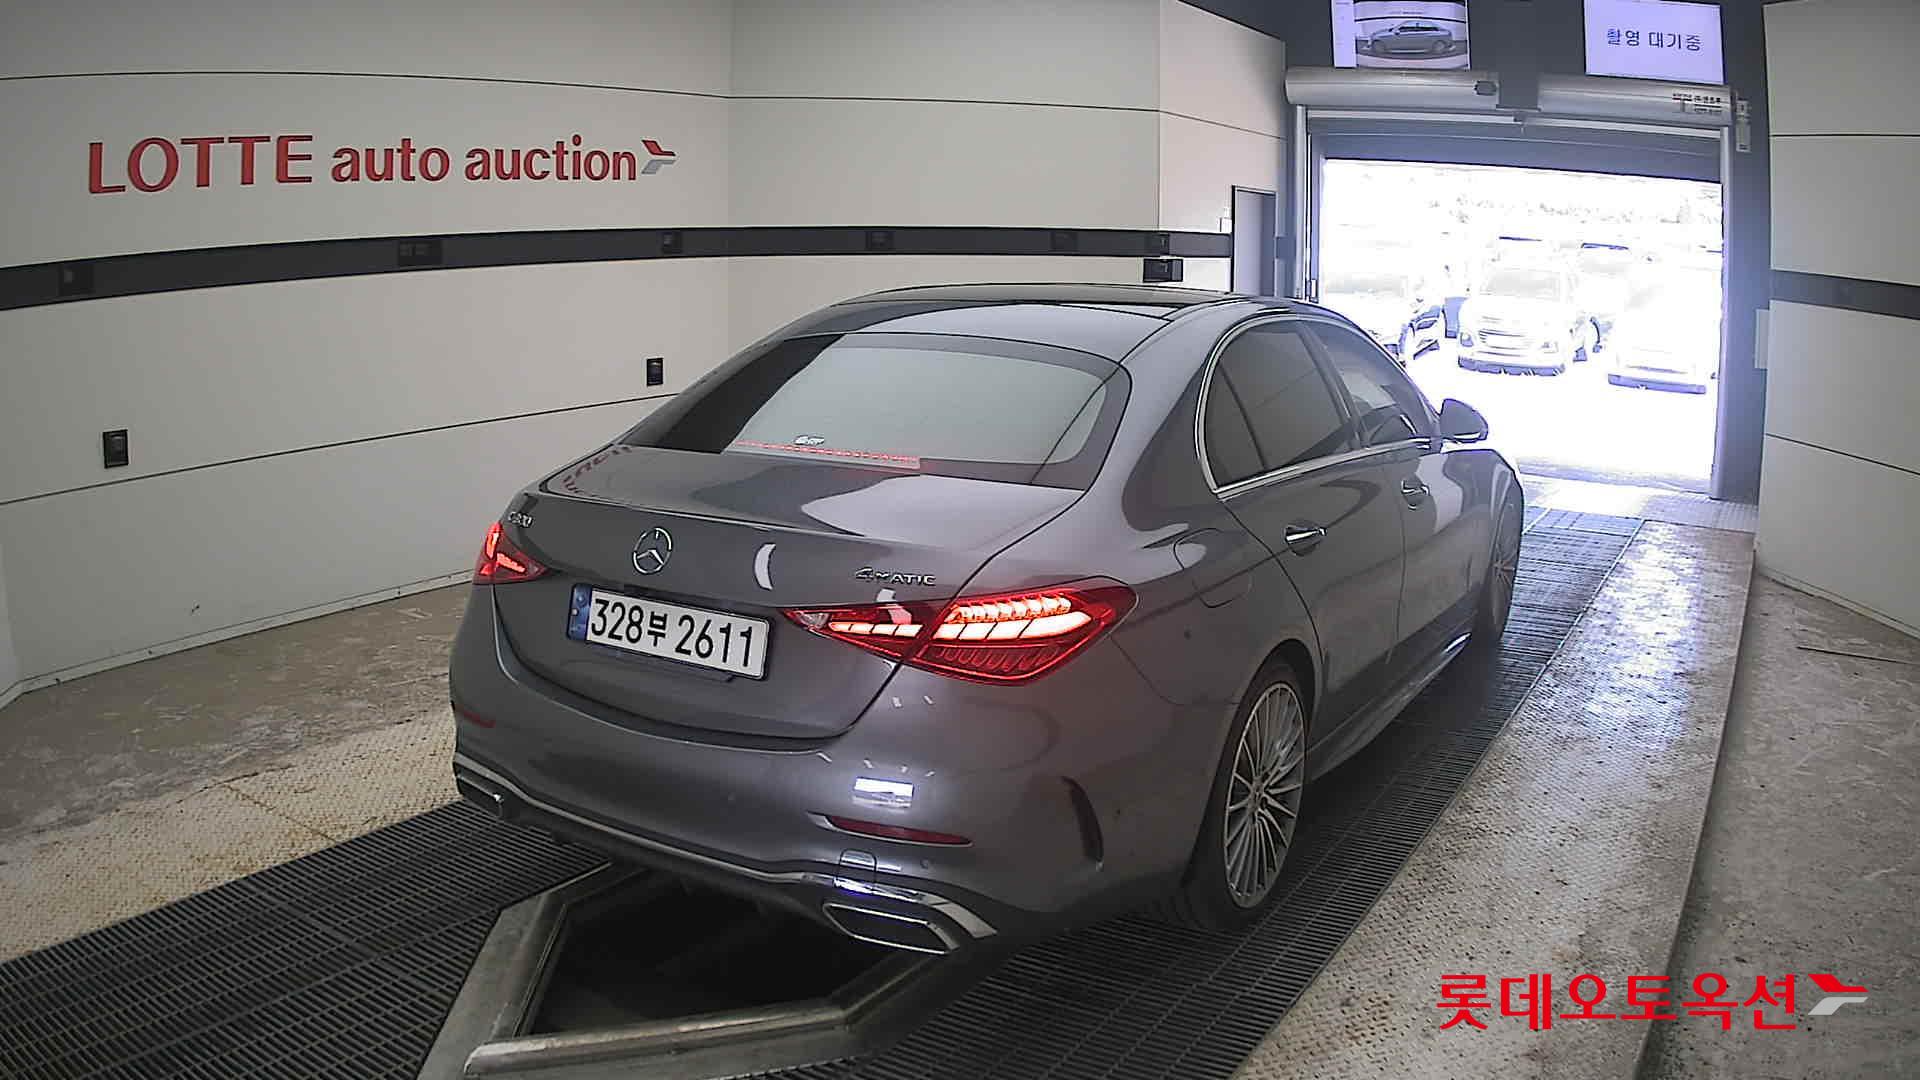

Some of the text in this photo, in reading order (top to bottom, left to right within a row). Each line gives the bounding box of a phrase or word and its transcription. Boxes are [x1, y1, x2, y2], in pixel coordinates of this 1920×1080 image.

[1648, 31, 1701, 51] 대기중
[88, 135, 637, 194] LOTTE auto auction
[591, 598, 753, 668] 328부 2611
